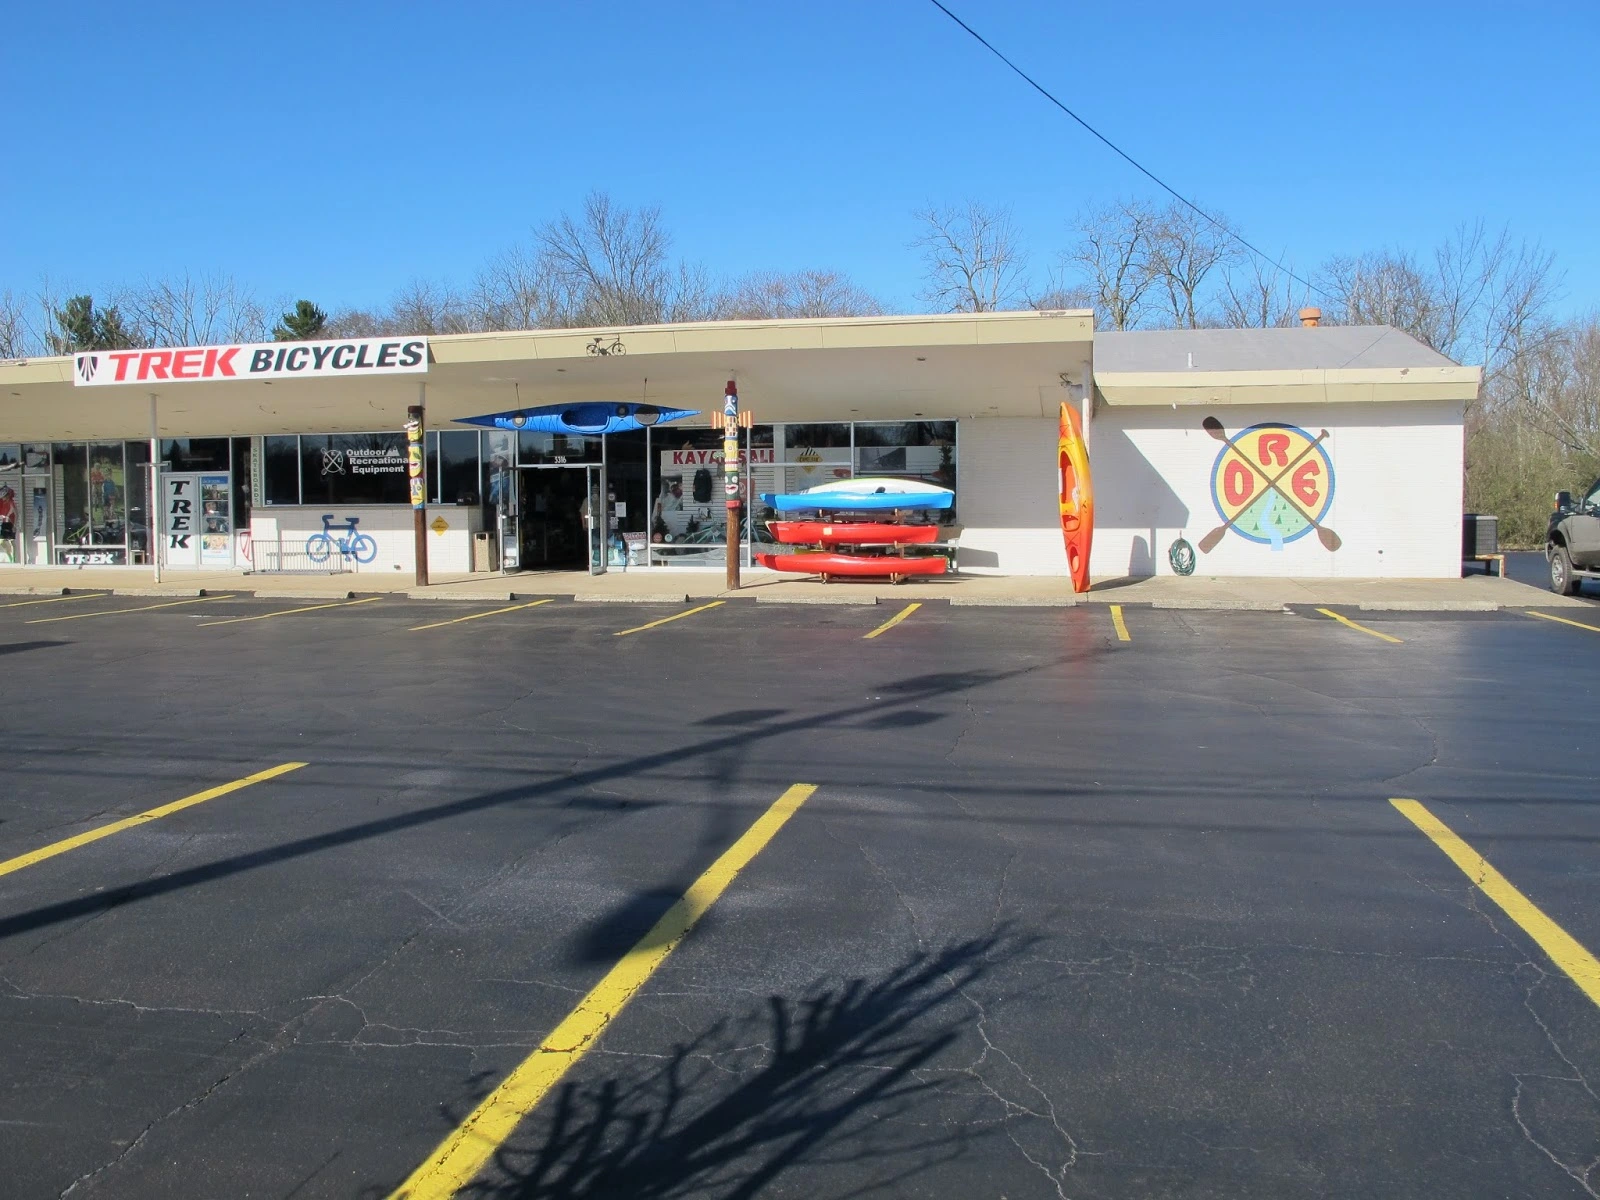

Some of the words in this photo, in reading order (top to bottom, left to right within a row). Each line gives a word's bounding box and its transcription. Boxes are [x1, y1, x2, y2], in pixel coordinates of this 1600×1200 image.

[108, 348, 242, 381] TREK
[250, 341, 425, 373] BICYCLES
[346, 448, 386, 456] Outdoor
[673, 450, 725, 464] KAYA
[349, 457, 409, 465] Recreationa
[352, 465, 405, 475] Equipment
[170, 480, 192, 549] TREK
[65, 552, 114, 565] TREK
